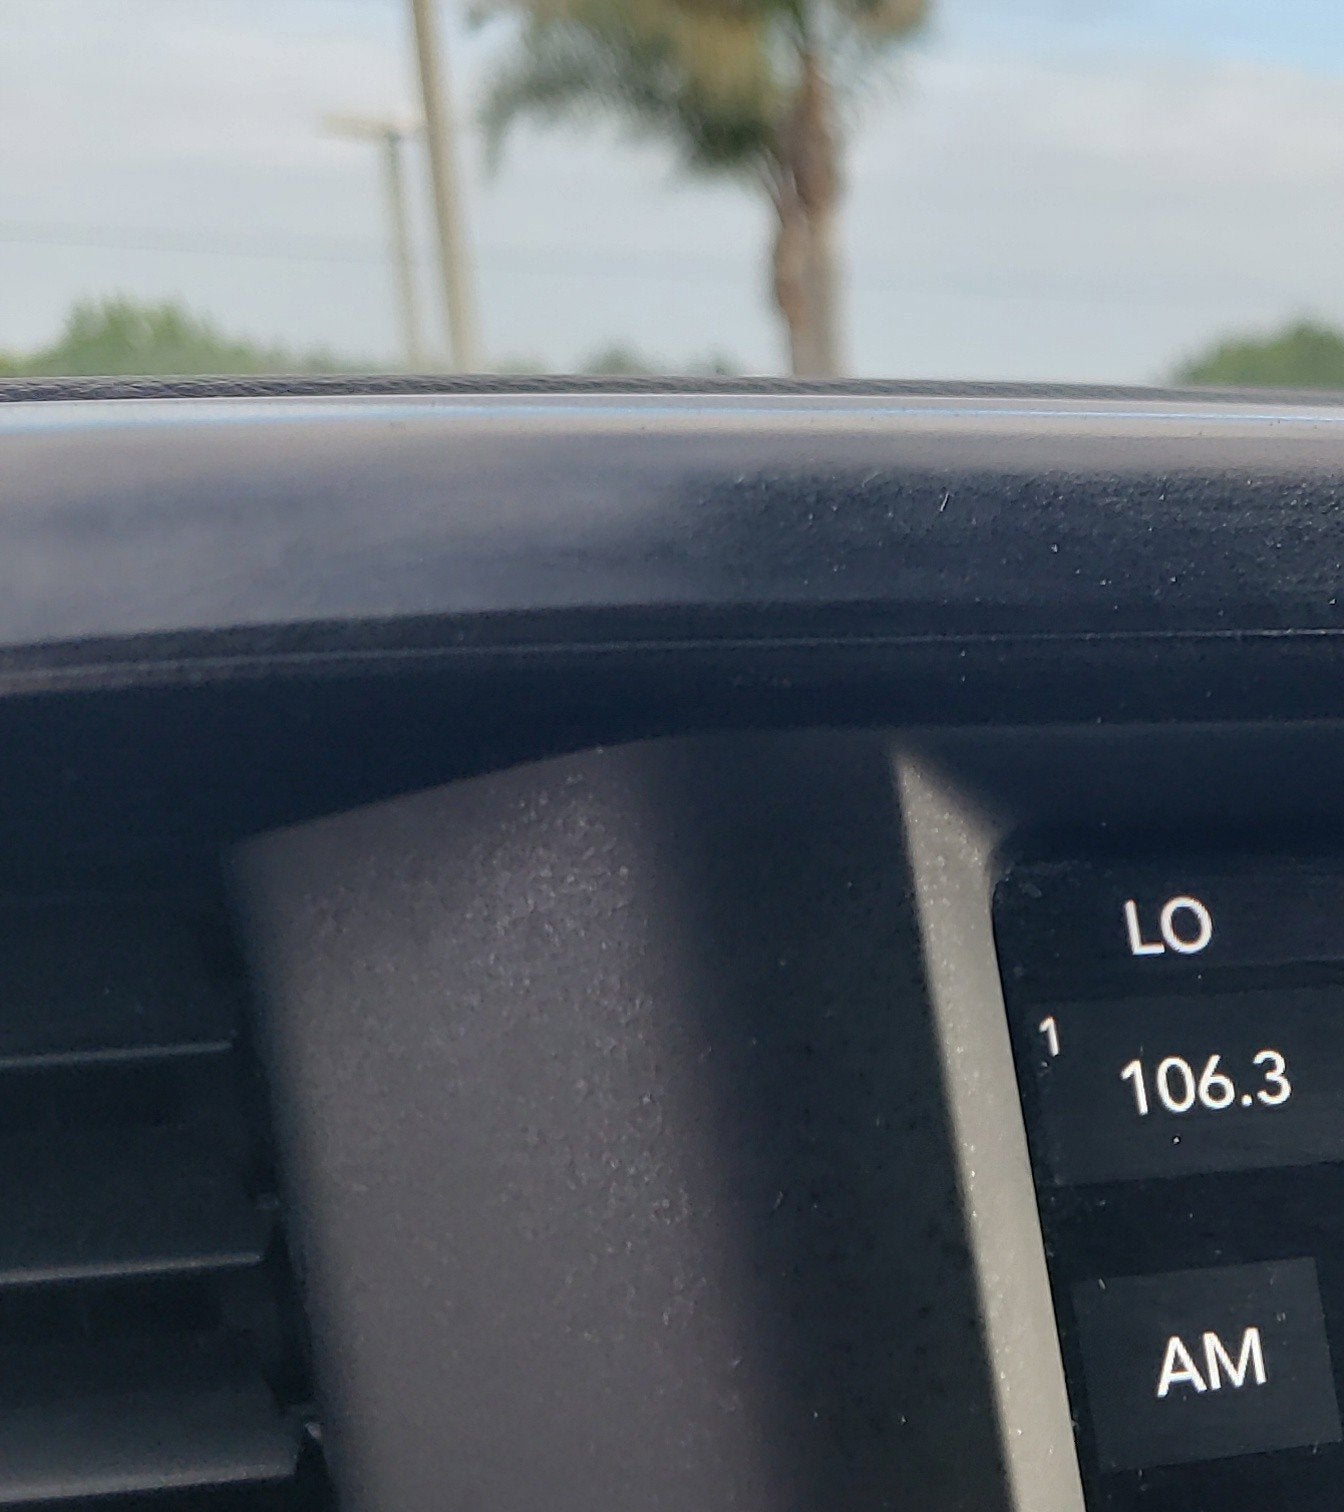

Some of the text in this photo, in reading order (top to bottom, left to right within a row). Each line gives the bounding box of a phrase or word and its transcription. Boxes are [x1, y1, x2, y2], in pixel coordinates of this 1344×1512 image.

[1124, 896, 1212, 955] LO
[1039, 1017, 1060, 1056] 1
[1121, 1049, 1292, 1116] 106.3
[1156, 1326, 1267, 1399] AM
